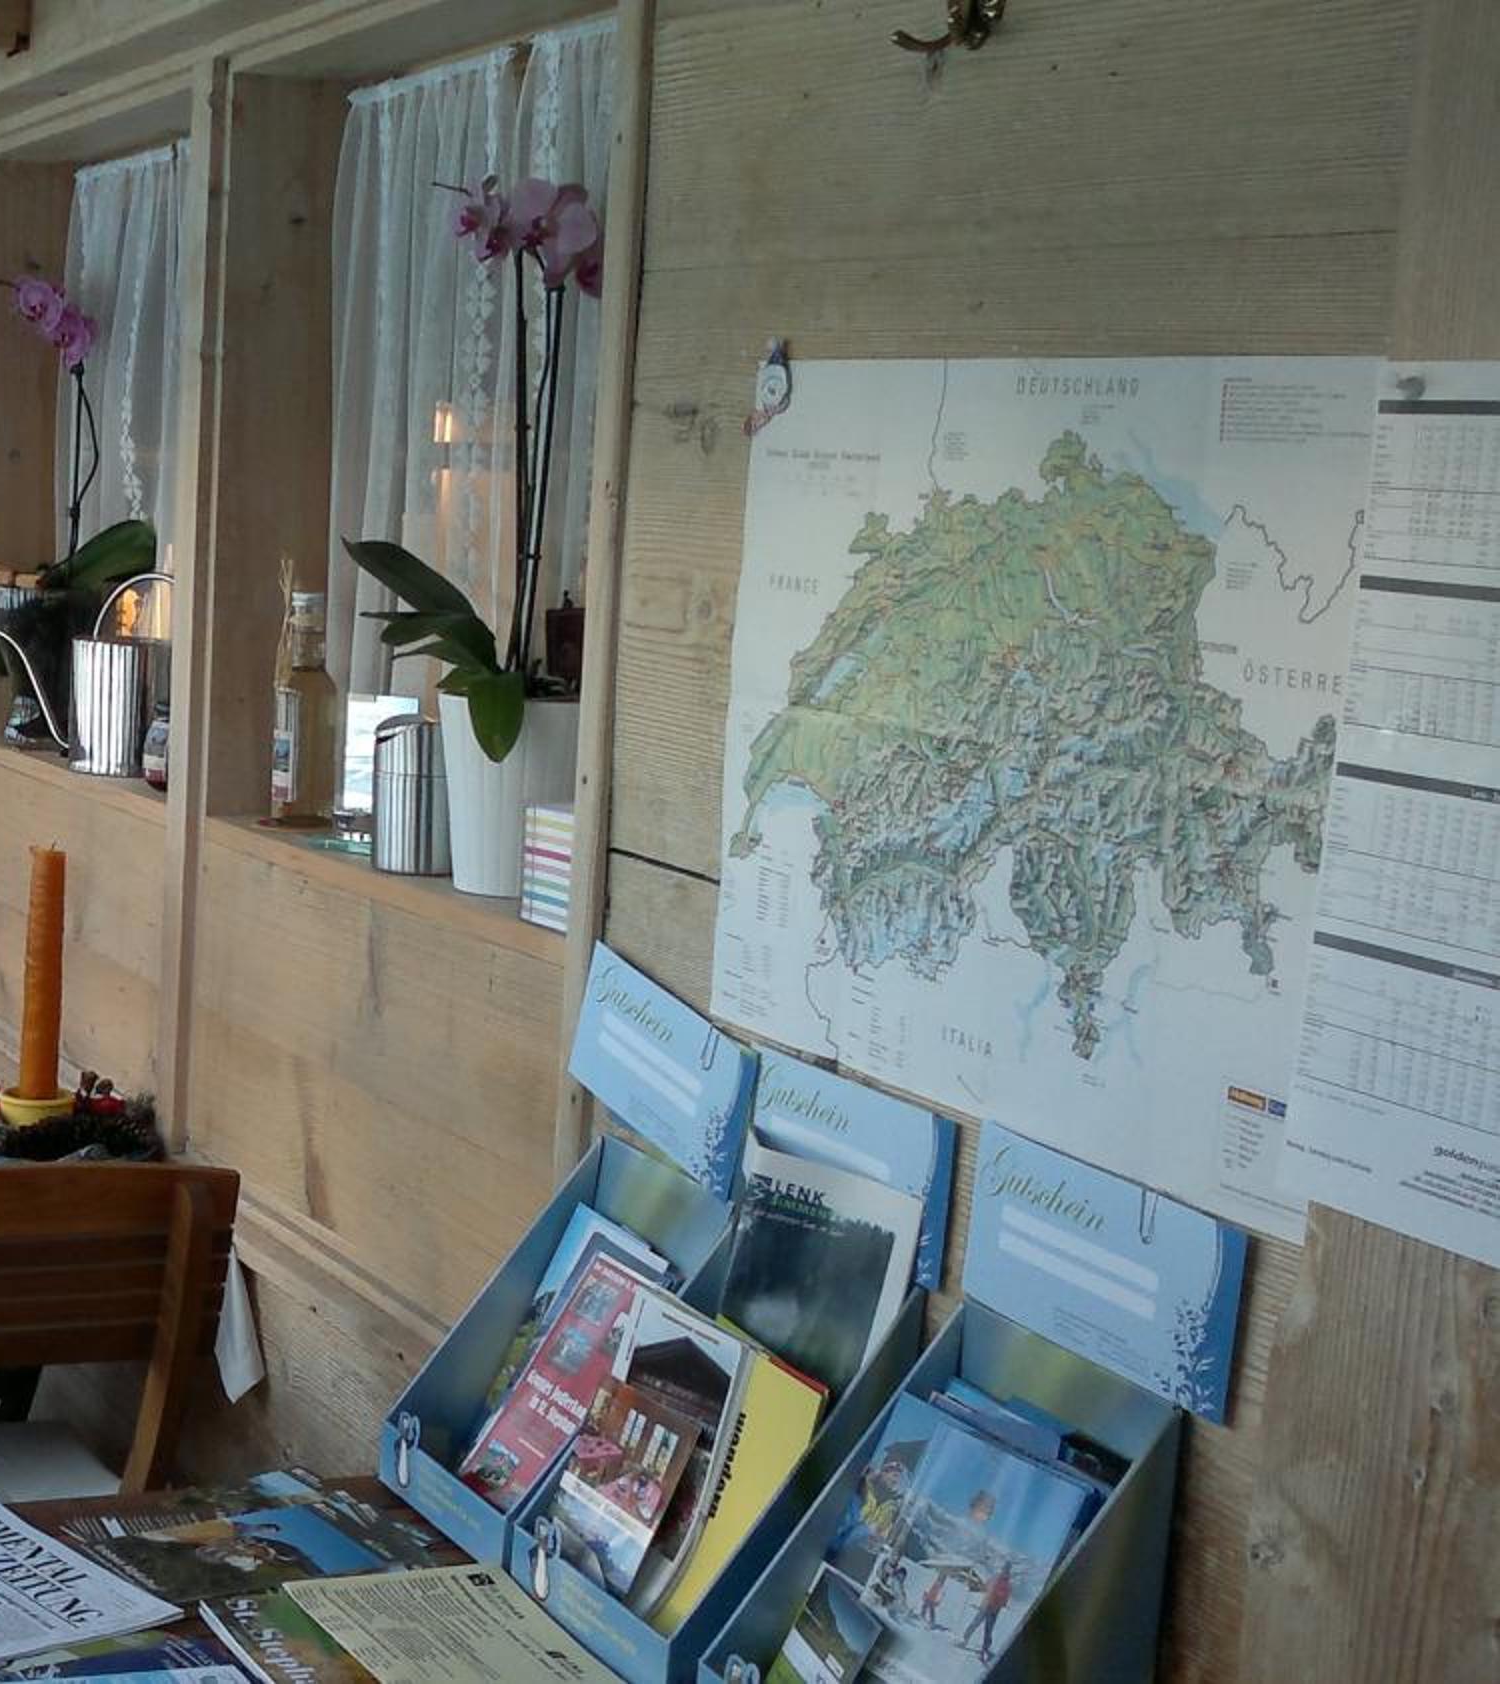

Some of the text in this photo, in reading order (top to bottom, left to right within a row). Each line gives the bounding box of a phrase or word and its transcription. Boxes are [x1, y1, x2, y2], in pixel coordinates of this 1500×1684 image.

[1015, 375, 1141, 399] DEUTSCHLAND
[768, 573, 820, 596] FRANCE
[1242, 658, 1343, 695] ÖSTERRE
[594, 964, 675, 1043] Gutschein
[941, 1024, 993, 1057] ITALIA
[756, 1063, 850, 1134] Gutschein
[774, 1180, 827, 1208] LENK
[979, 1144, 1105, 1232] Gutschein
